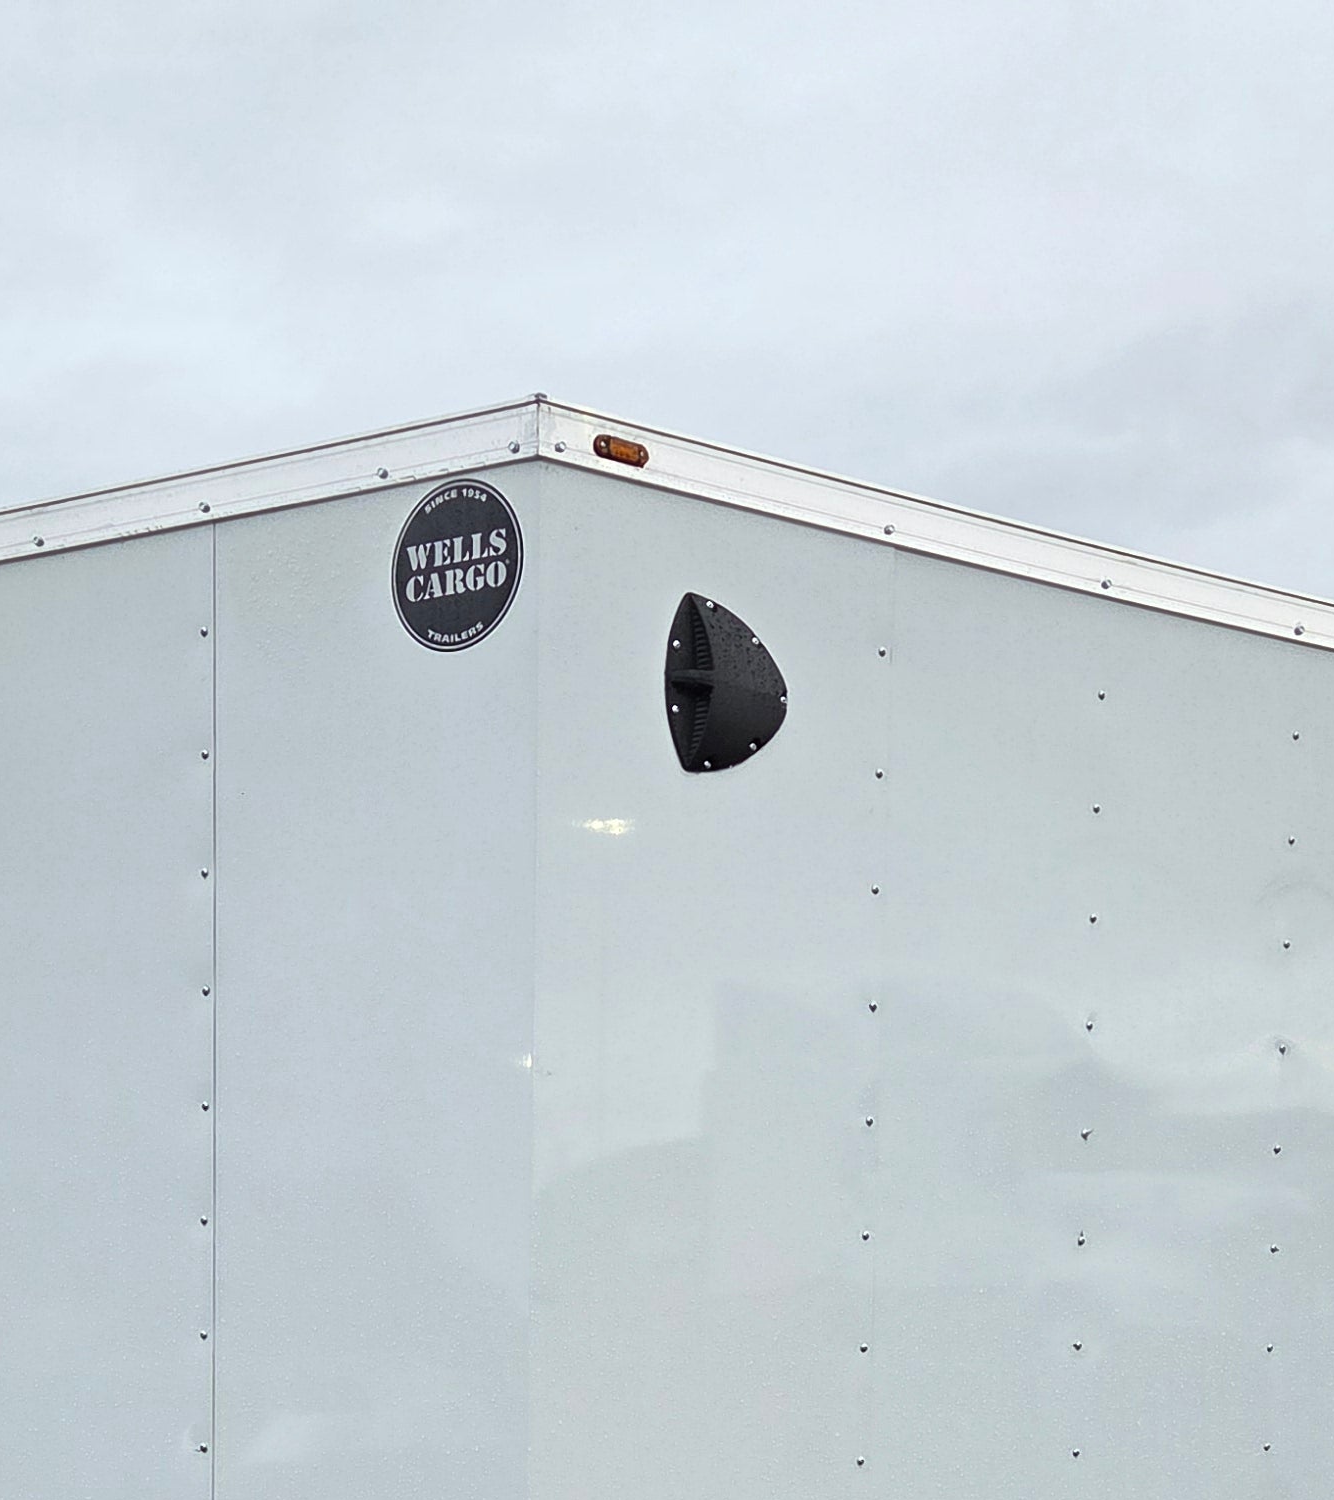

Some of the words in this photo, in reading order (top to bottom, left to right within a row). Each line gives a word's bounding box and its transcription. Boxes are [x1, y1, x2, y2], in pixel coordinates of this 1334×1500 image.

[424, 489, 458, 514] SINCE
[462, 487, 487, 502] 1954
[406, 528, 507, 572] WELLS
[405, 560, 508, 603] CARGO
[427, 621, 484, 643] TRAILERS
